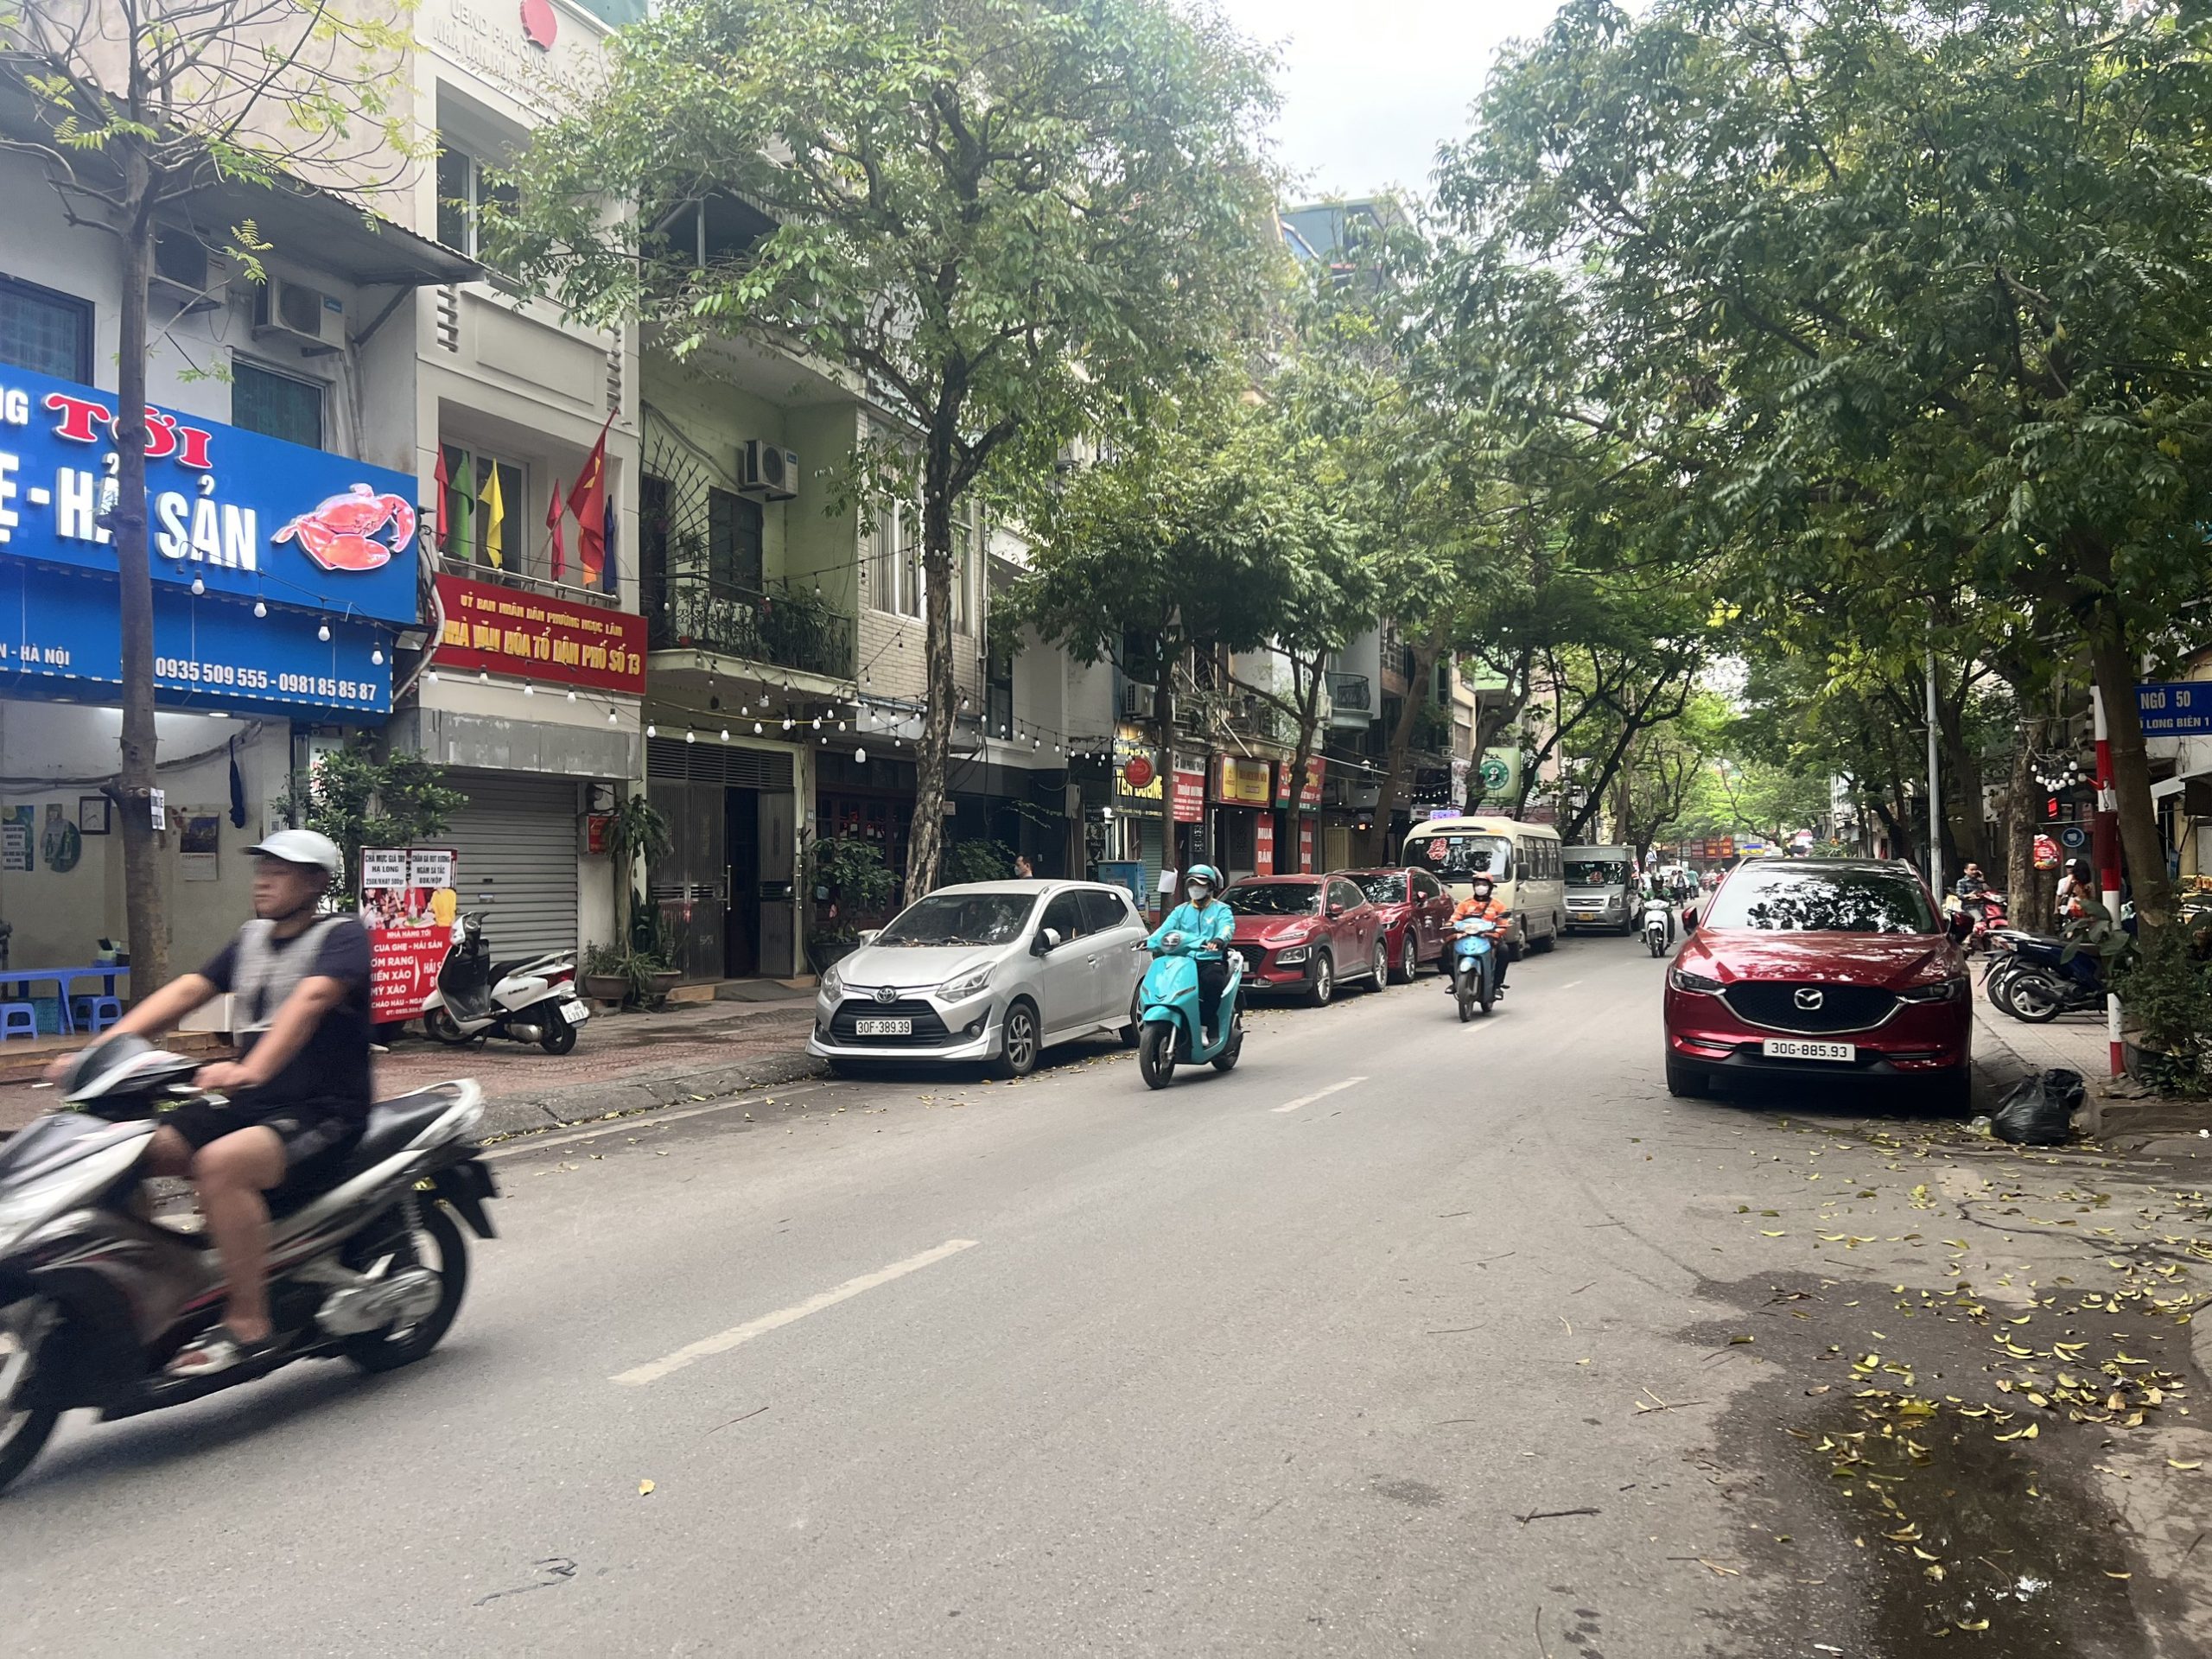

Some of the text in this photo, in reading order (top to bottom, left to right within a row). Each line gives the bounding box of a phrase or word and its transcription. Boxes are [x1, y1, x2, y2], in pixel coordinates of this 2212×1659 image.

[156, 474, 257, 571] SẢN
[477, 598, 496, 613] BAN
[499, 602, 524, 618] NHÂN
[526, 607, 545, 622] DÂN
[547, 612, 580, 628] PHƯỜNG
[582, 619, 603, 634] NGỌC
[606, 622, 622, 637] LÂM
[473, 620, 500, 652] VĂN
[533, 626, 550, 660] TỔ
[553, 636, 579, 665] DÂN
[582, 639, 608, 670] PHỐ
[608, 643, 626, 672] SỐ
[627, 653, 640, 675] 13
[21, 644, 40, 662] HÀ
[45, 647, 70, 668] NỘI
[156, 658, 200, 681] 0935
[202, 664, 233, 684] 509
[237, 669, 268, 689] 555
[279, 673, 315, 694] 0981
[317, 678, 336, 696] 85
[338, 681, 357, 699] 85
[359, 683, 377, 702] 87
[2140, 689, 2190, 709] NGÕ 50
[2146, 719, 2173, 728] LONG
[2176, 716, 2201, 728] BIÊN
[2204, 717, 2209, 727] 1
[1257, 828, 1273, 840] MUA
[1257, 849, 1272, 863] BÁN
[374, 944, 390, 952] CUA
[371, 956, 414, 968] ƠM RANG
[857, 1021, 910, 1033] 30F-389.39
[1771, 1042, 1847, 1058] 30G-885.93
